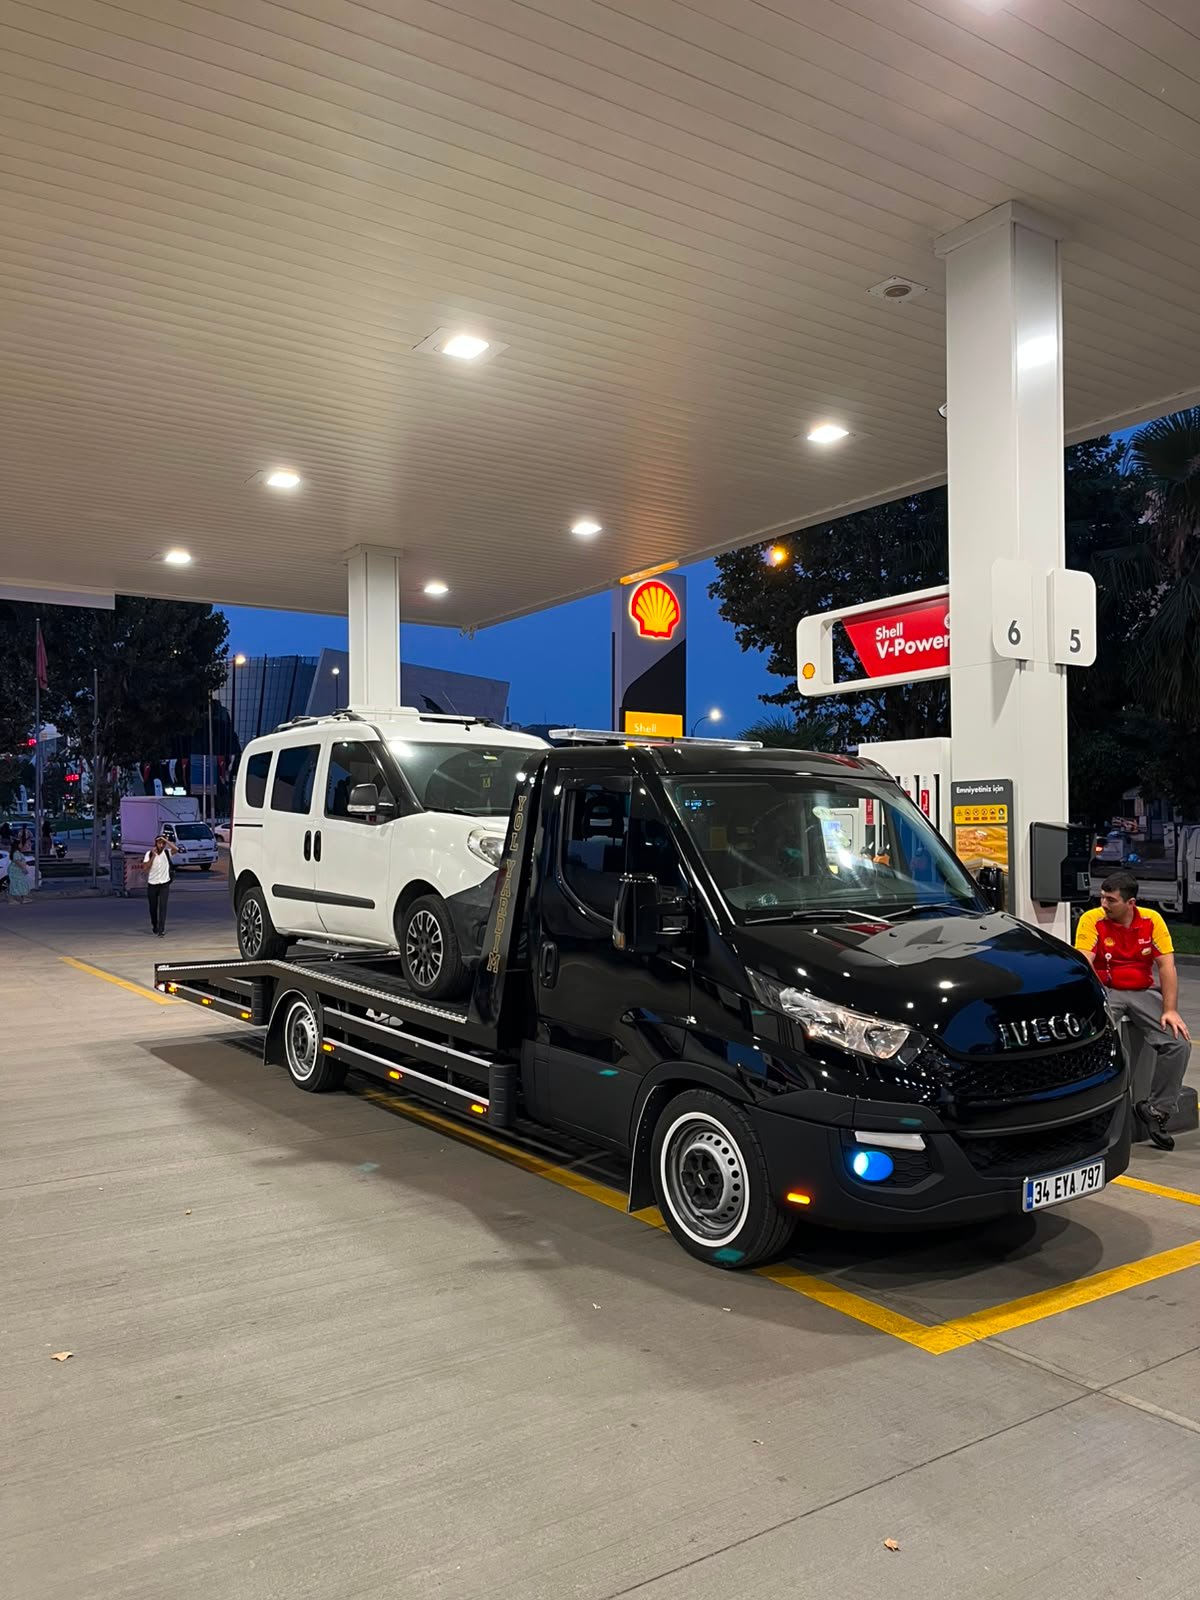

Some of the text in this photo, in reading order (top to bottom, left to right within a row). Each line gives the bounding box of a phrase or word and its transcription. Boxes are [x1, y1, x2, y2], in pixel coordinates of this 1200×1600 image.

[876, 622, 903, 640] Shell
[1008, 620, 1021, 645] 6
[1070, 629, 1081, 653] 5
[876, 635, 950, 659] V-Power
[634, 723, 657, 733] Shell
[956, 784, 1004, 794] Emniyetiniz için
[487, 796, 527, 973] YOL YARDIM
[999, 1013, 1080, 1049] IVECO
[1035, 1165, 1101, 1204] 34 EYA 797
